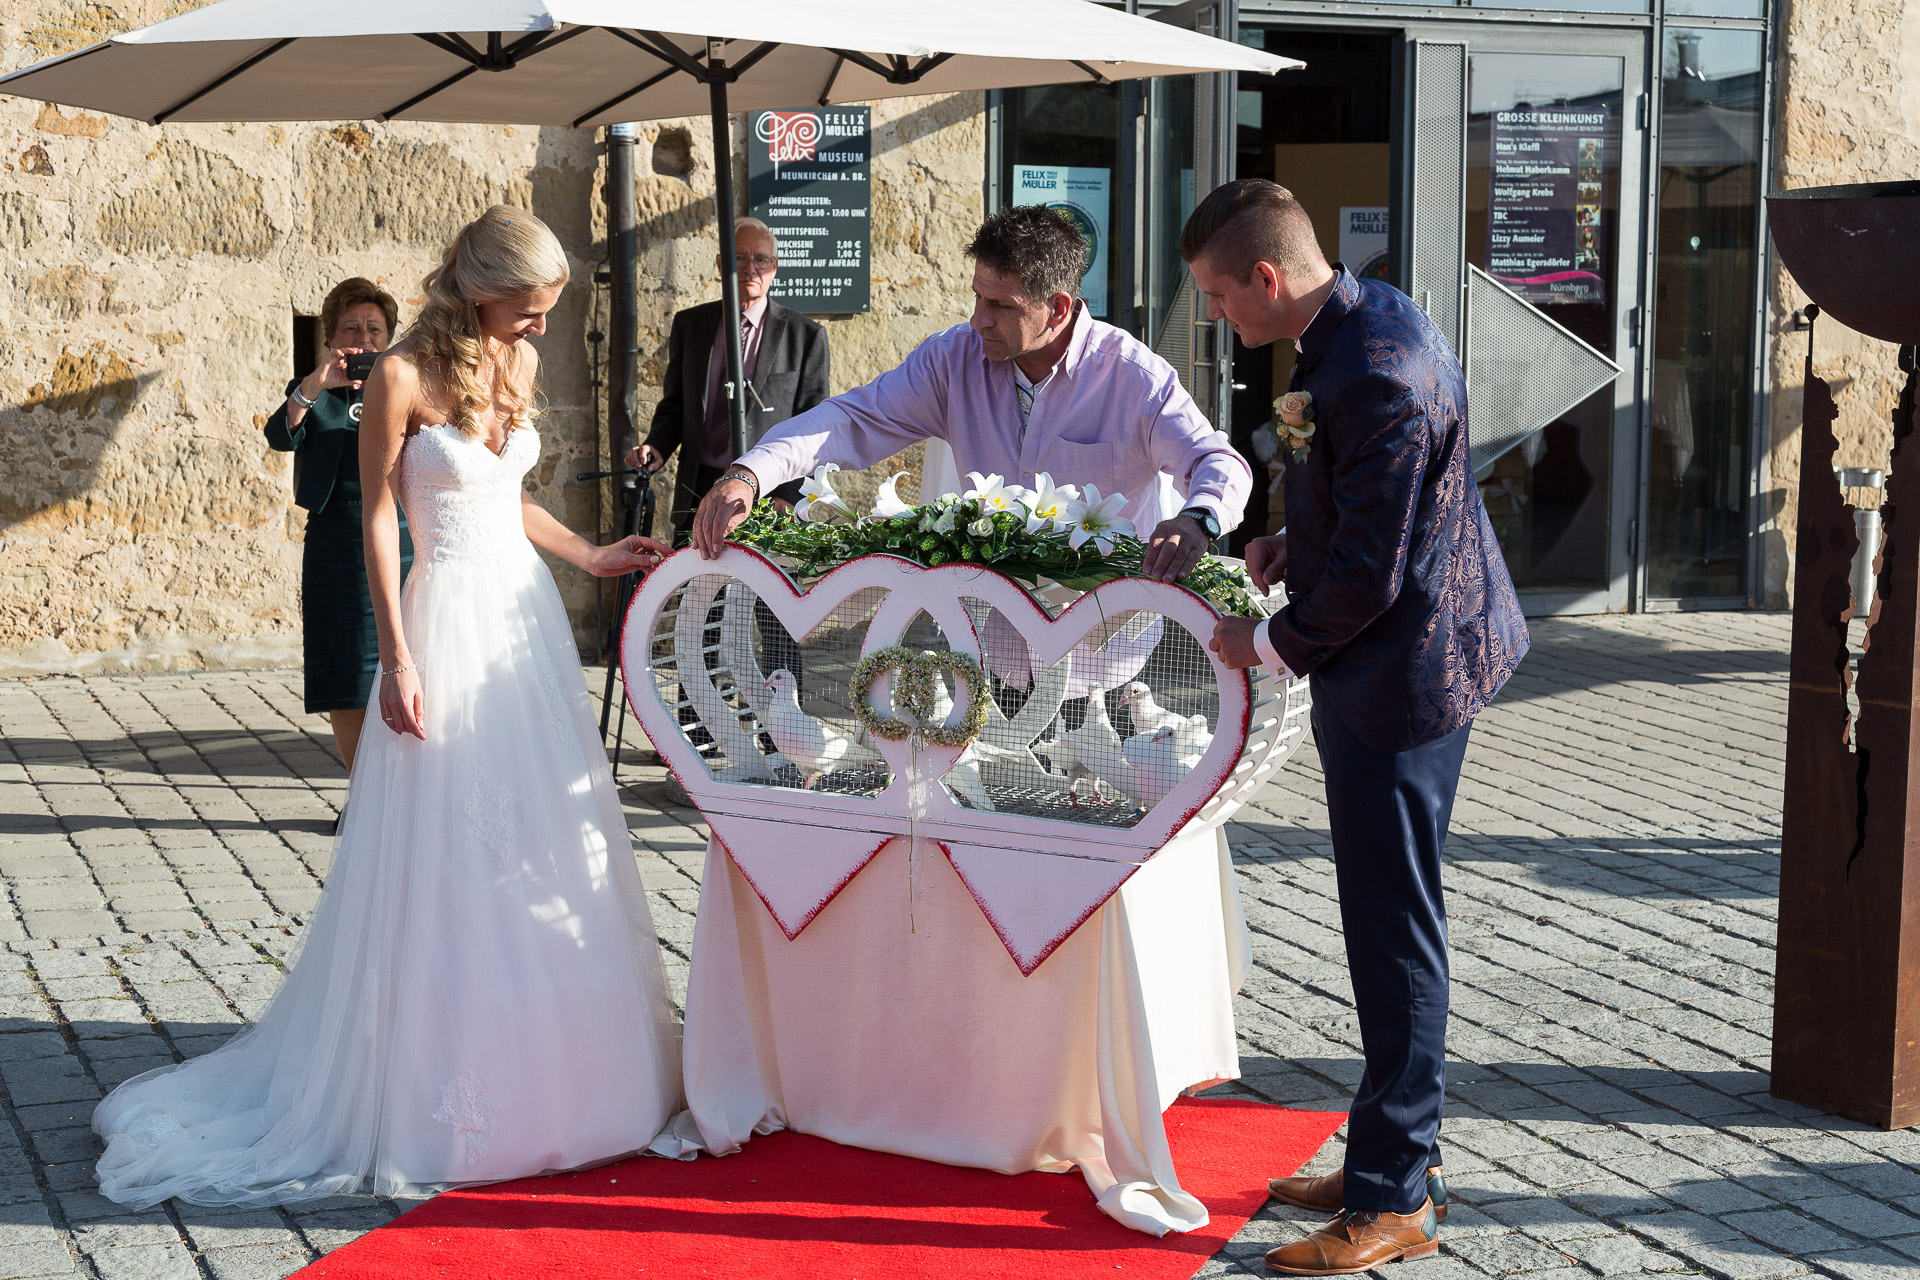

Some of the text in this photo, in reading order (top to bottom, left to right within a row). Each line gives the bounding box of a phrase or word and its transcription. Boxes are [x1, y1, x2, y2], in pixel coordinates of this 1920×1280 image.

[825, 114, 864, 125] FELIX
[1496, 112, 1605, 124] GROSSE KLEINKUNST
[825, 125, 864, 136] MÜLLER
[1496, 142, 1517, 151] Han's
[819, 152, 864, 162] MUSEUM
[1022, 170, 1045, 179] FELIX
[1496, 165, 1571, 174] Helmut Haberkamm
[781, 172, 866, 181] NEUNKIRCHEN A. BR.
[1022, 179, 1057, 189] MÜLLER
[1494, 187, 1554, 198] Wolfgang Krebs
[768, 195, 831, 205] ÖFFNUNGSZEITEN:
[768, 208, 802, 217] SONNTAG
[806, 208, 825, 217] 15:00
[832, 208, 849, 217] 17:00
[851, 208, 866, 217] UHR
[1350, 212, 1381, 222] FELIX
[1493, 212, 1508, 220] TBC
[1350, 223, 1389, 234] MÜLLE
[1492, 234, 1545, 244] Lizzy Aumeier
[777, 240, 813, 248] WACHSENE
[836, 240, 852, 249] 2,00
[777, 247, 861, 259] MÄSSIGT 1,00 €
[777, 259, 860, 267] HRUNGEN AUF ANFRAGE
[1491, 258, 1571, 268] Matthias Egersdörfer
[788, 278, 794, 287] 0
[794, 278, 803, 287] 91
[804, 278, 814, 287] 34
[821, 278, 831, 287] 90
[843, 278, 852, 287] 42
[1550, 283, 1589, 292] Nürnberg
[768, 287, 786, 297] oder
[788, 288, 794, 297] 0
[794, 288, 803, 297] 91
[804, 288, 814, 297] 34
[822, 288, 831, 297] 18
[832, 288, 842, 297] 37
[1575, 290, 1601, 299] Musik
